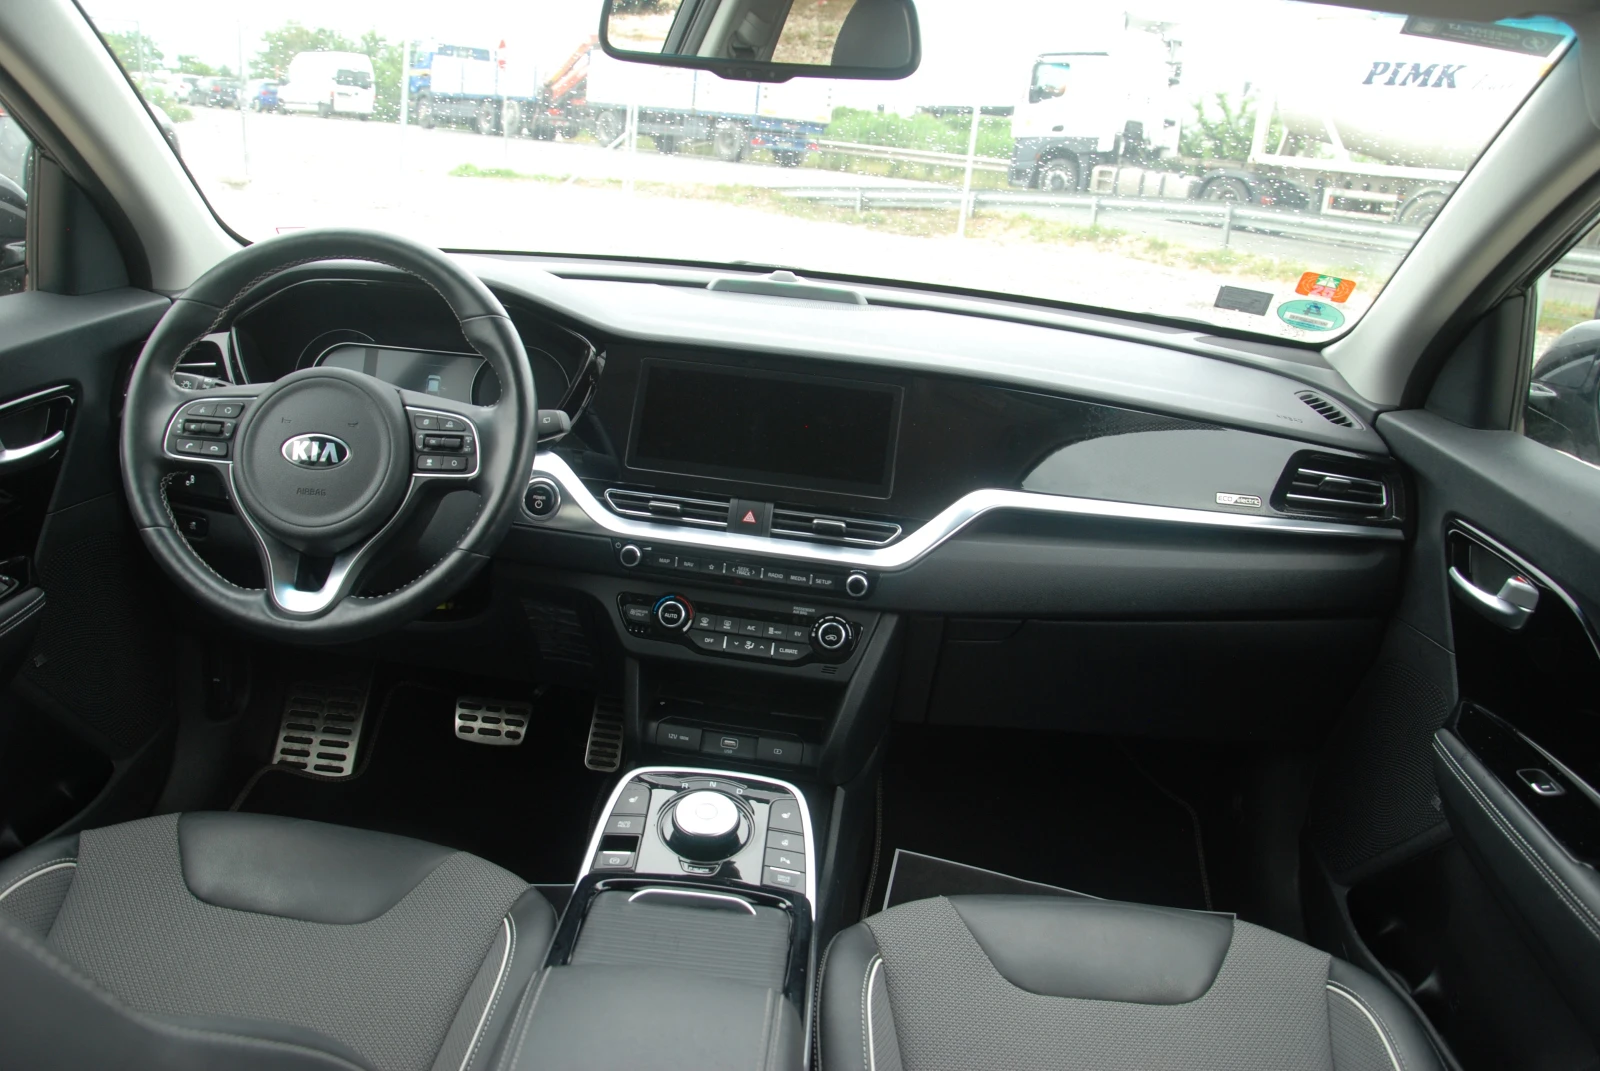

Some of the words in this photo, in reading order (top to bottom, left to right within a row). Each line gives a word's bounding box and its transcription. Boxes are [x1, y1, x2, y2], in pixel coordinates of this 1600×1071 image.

[1362, 61, 1467, 89] PIMK
[1309, 284, 1336, 299] 25
[291, 440, 339, 464] KIA
[296, 488, 326, 497] AIRBAG
[1217, 494, 1233, 503] ECO
[1236, 496, 1260, 506] electric
[779, 647, 798, 655] CLIMATE
